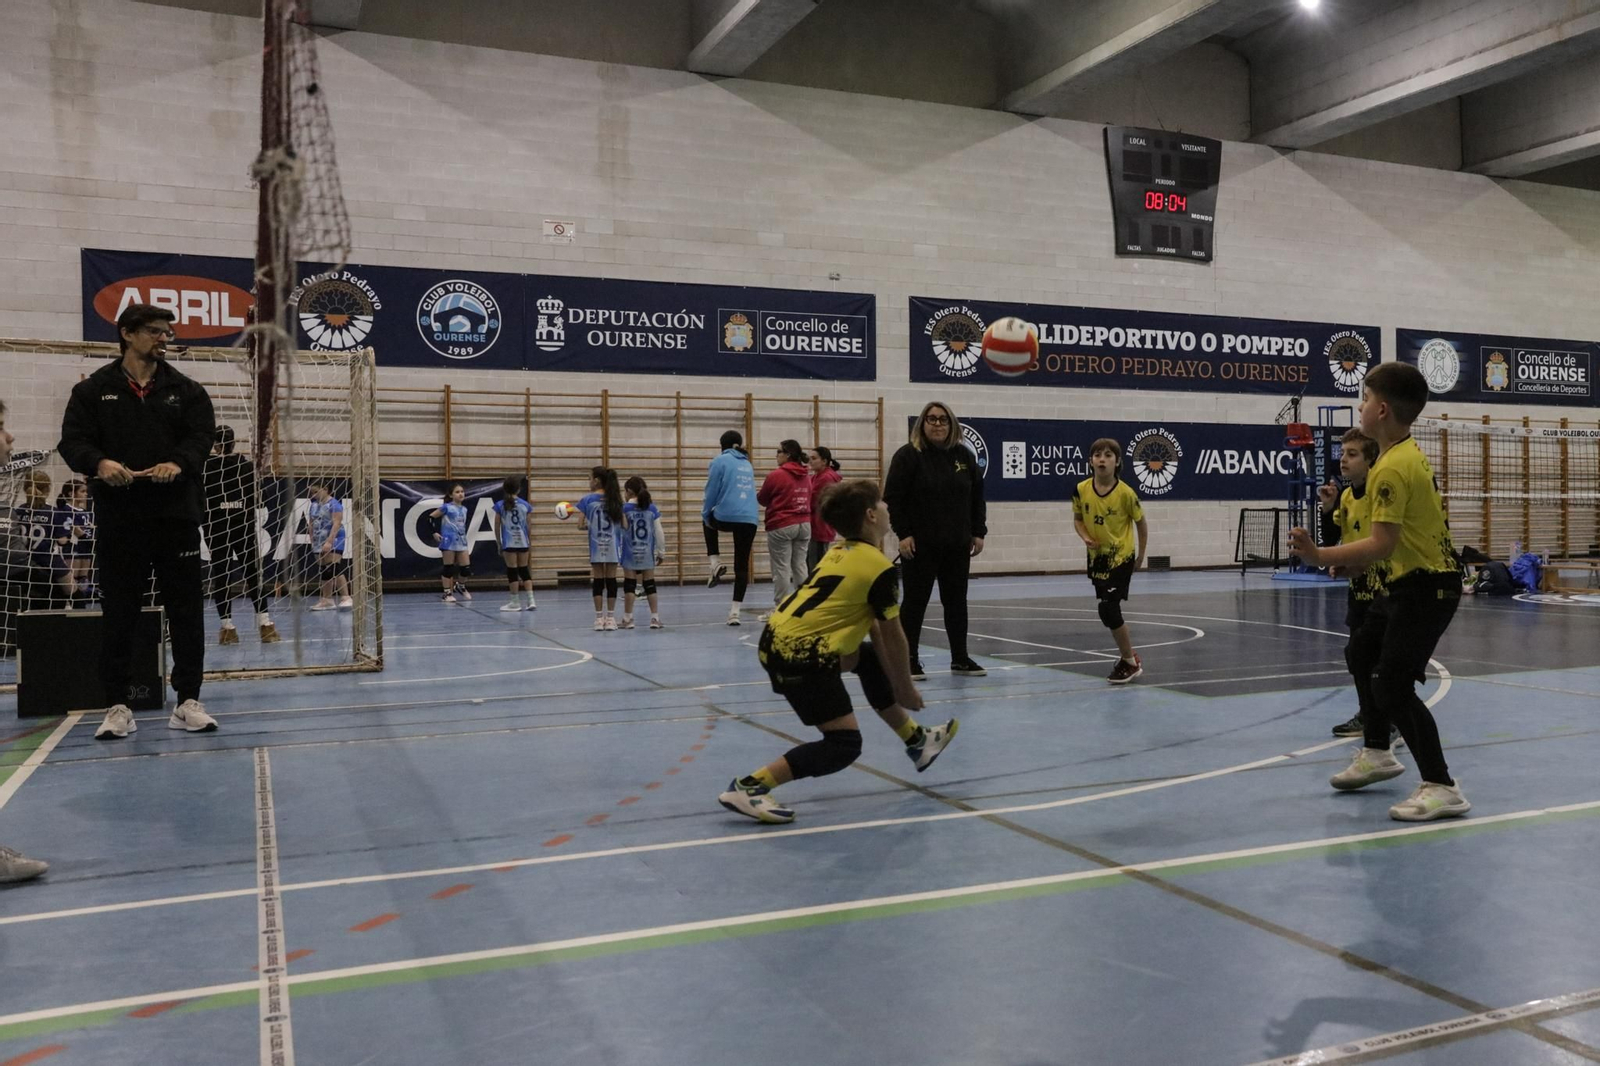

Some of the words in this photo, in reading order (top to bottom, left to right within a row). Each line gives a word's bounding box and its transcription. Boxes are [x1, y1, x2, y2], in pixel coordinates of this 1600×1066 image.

[1129, 137, 1147, 146] LOCAL
[1181, 143, 1207, 153] VISITANTE
[1155, 178, 1176, 186] PERIODO
[1145, 191, 1187, 211] 08:04
[1191, 213, 1213, 222] MONDO
[1156, 246, 1176, 254] JUGADOR
[341, 270, 382, 310] Pedrayo
[423, 287, 446, 311] CLUB
[446, 283, 496, 314] VOLEIBOL
[567, 307, 705, 330] DEPUTACIÓN
[765, 315, 828, 333] Concello
[831, 318, 849, 334] de
[923, 318, 937, 336] IES
[934, 305, 960, 320] Otero
[433, 332, 486, 343] OURENSE
[587, 329, 688, 349] OURENSE
[765, 334, 863, 353] OURENSE
[1201, 331, 1217, 354] O
[1222, 333, 1310, 358] POMPEO
[1322, 341, 1333, 356] IES
[1330, 330, 1351, 342] Otero
[1351, 330, 1373, 359] Pedrayo
[447, 345, 474, 356] 1989
[1517, 350, 1560, 366] Concello
[1563, 353, 1576, 367] de
[938, 362, 978, 378] Ourense
[1045, 354, 1116, 376] OTERO
[1121, 358, 1216, 378] PEDRAYO.
[1220, 363, 1309, 383] OURENSE
[1449, 354, 1458, 383] DEPORTES
[1517, 365, 1586, 382] OURENSE
[1333, 380, 1360, 393] Ourens
[1551, 384, 1560, 393] de
[1560, 385, 1587, 395] Deportes
[1126, 440, 1137, 457] IES
[1134, 428, 1158, 441] Otero
[1158, 427, 1183, 457] Pedrayo
[1542, 429, 1558, 437] CLUB
[1559, 429, 1589, 438] VOLEIBOL
[1589, 430, 1600, 438] OU
[1031, 445, 1083, 459] XUNTA
[1031, 461, 1055, 475] DE
[1139, 483, 1173, 496] Ourense
[511, 509, 520, 525] 8
[630, 518, 648, 540] 18
[1353, 520, 1360, 532] 4
